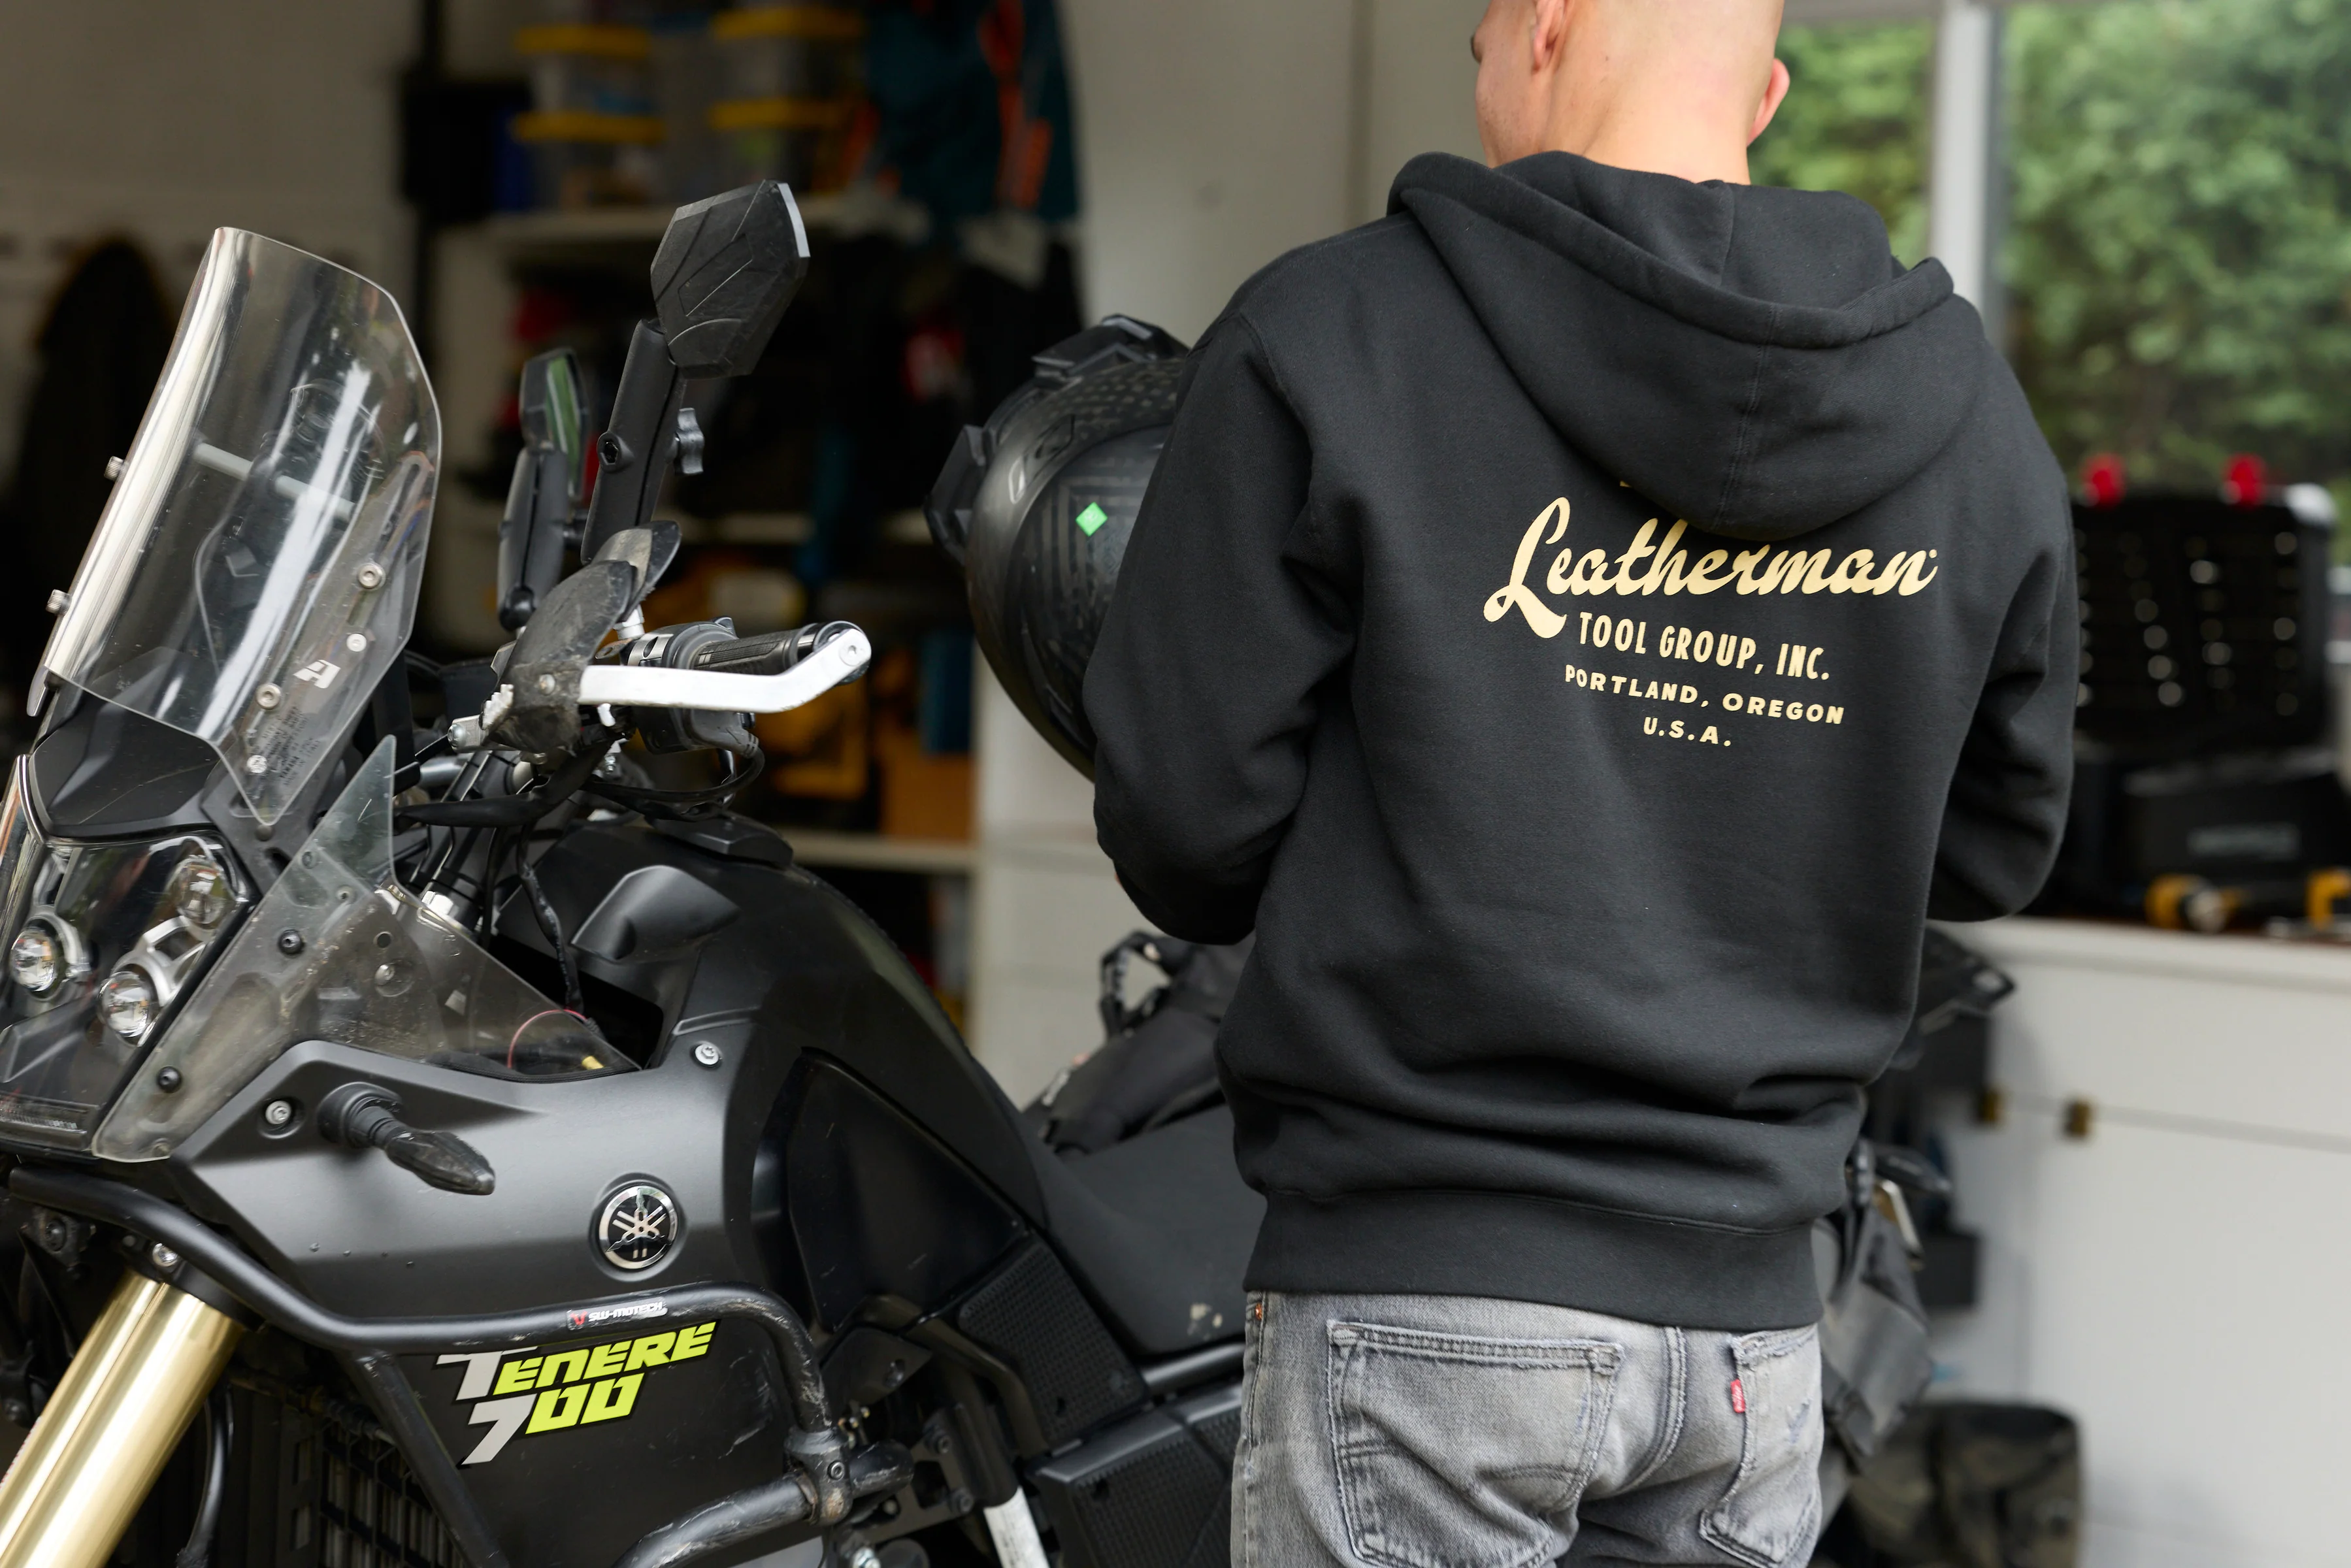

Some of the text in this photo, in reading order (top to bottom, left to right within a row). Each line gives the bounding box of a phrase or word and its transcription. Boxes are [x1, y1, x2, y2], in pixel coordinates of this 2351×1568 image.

[1483, 497, 1938, 639] Leatherman
[1579, 611, 1830, 680] TOOL GROUP, INC.
[1565, 664, 1845, 725] PORTLAND, OREGON
[1643, 716, 1731, 747] U.S.A.
[589, 1301, 663, 1322] SW-MOTECH
[461, 1372, 645, 1465] 700
